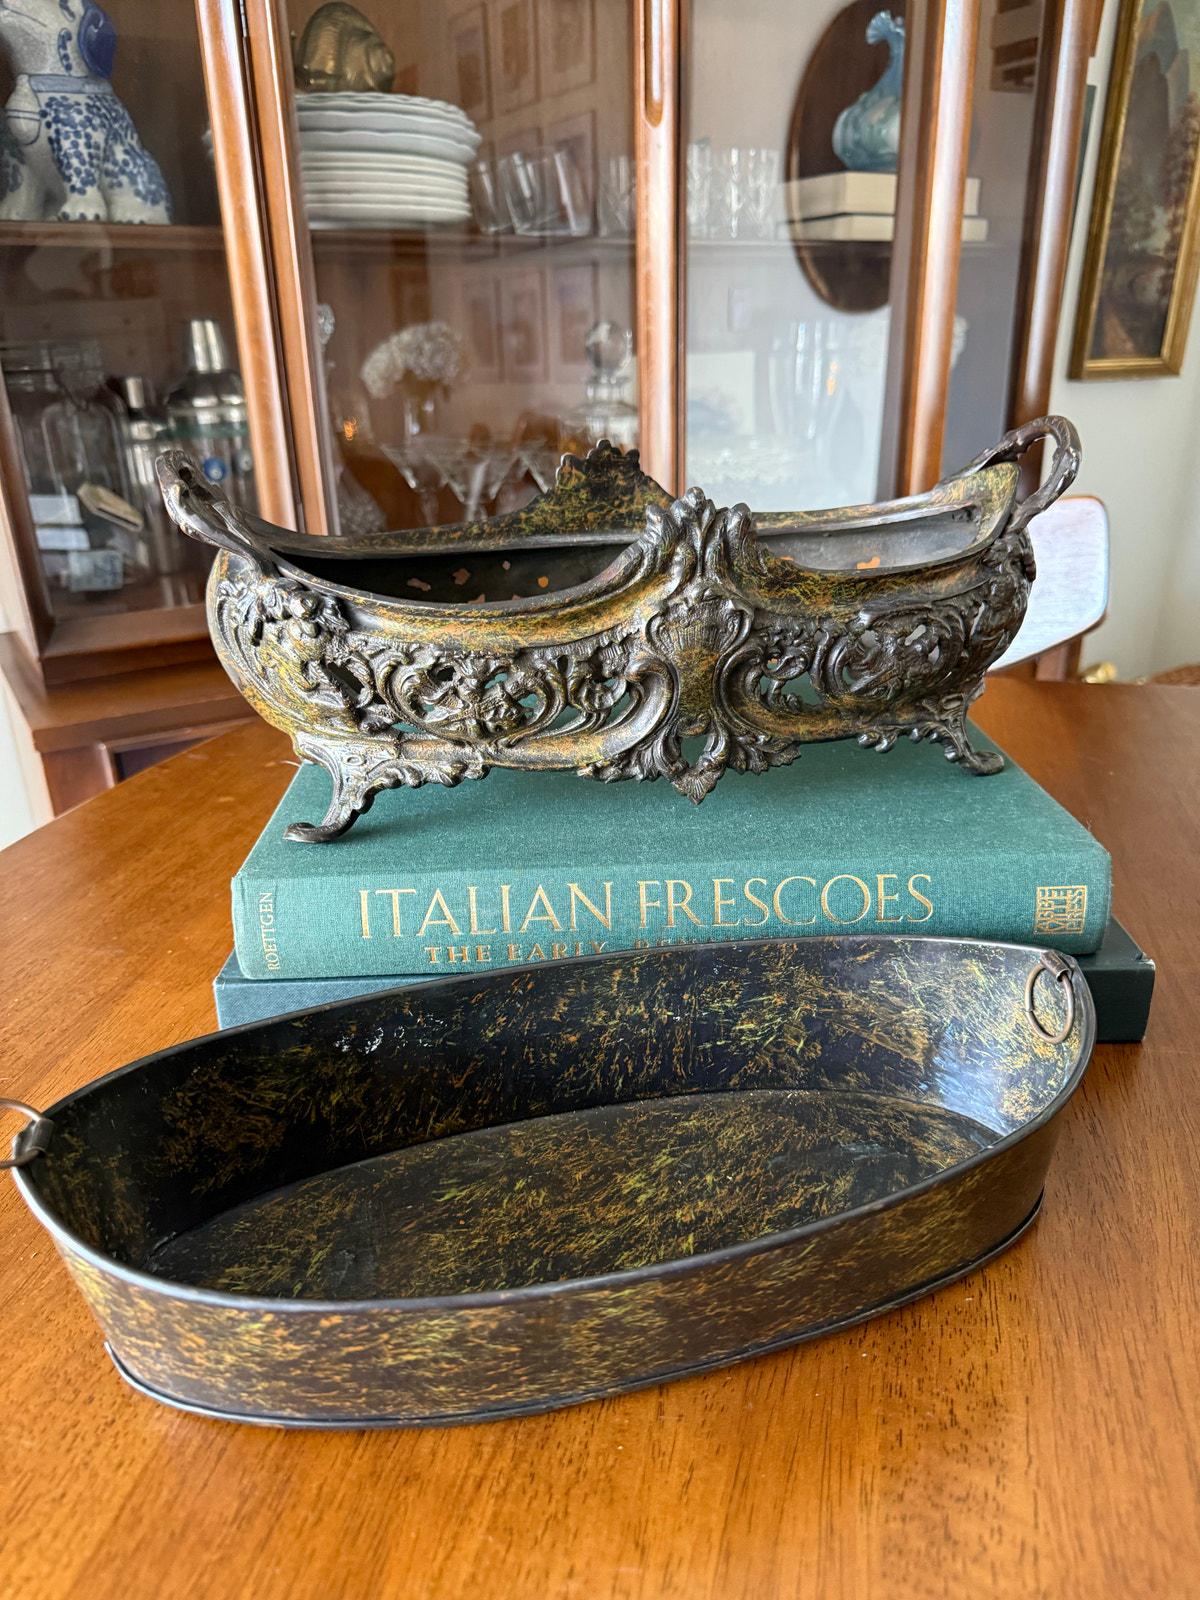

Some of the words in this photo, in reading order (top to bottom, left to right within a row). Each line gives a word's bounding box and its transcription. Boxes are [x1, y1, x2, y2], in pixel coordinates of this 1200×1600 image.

[259, 892, 281, 970] ROETTGEN
[358, 881, 613, 938] ITALIAN
[636, 873, 934, 929] FRESCOES
[424, 943, 493, 964] THE
[507, 940, 609, 961] EARLY
